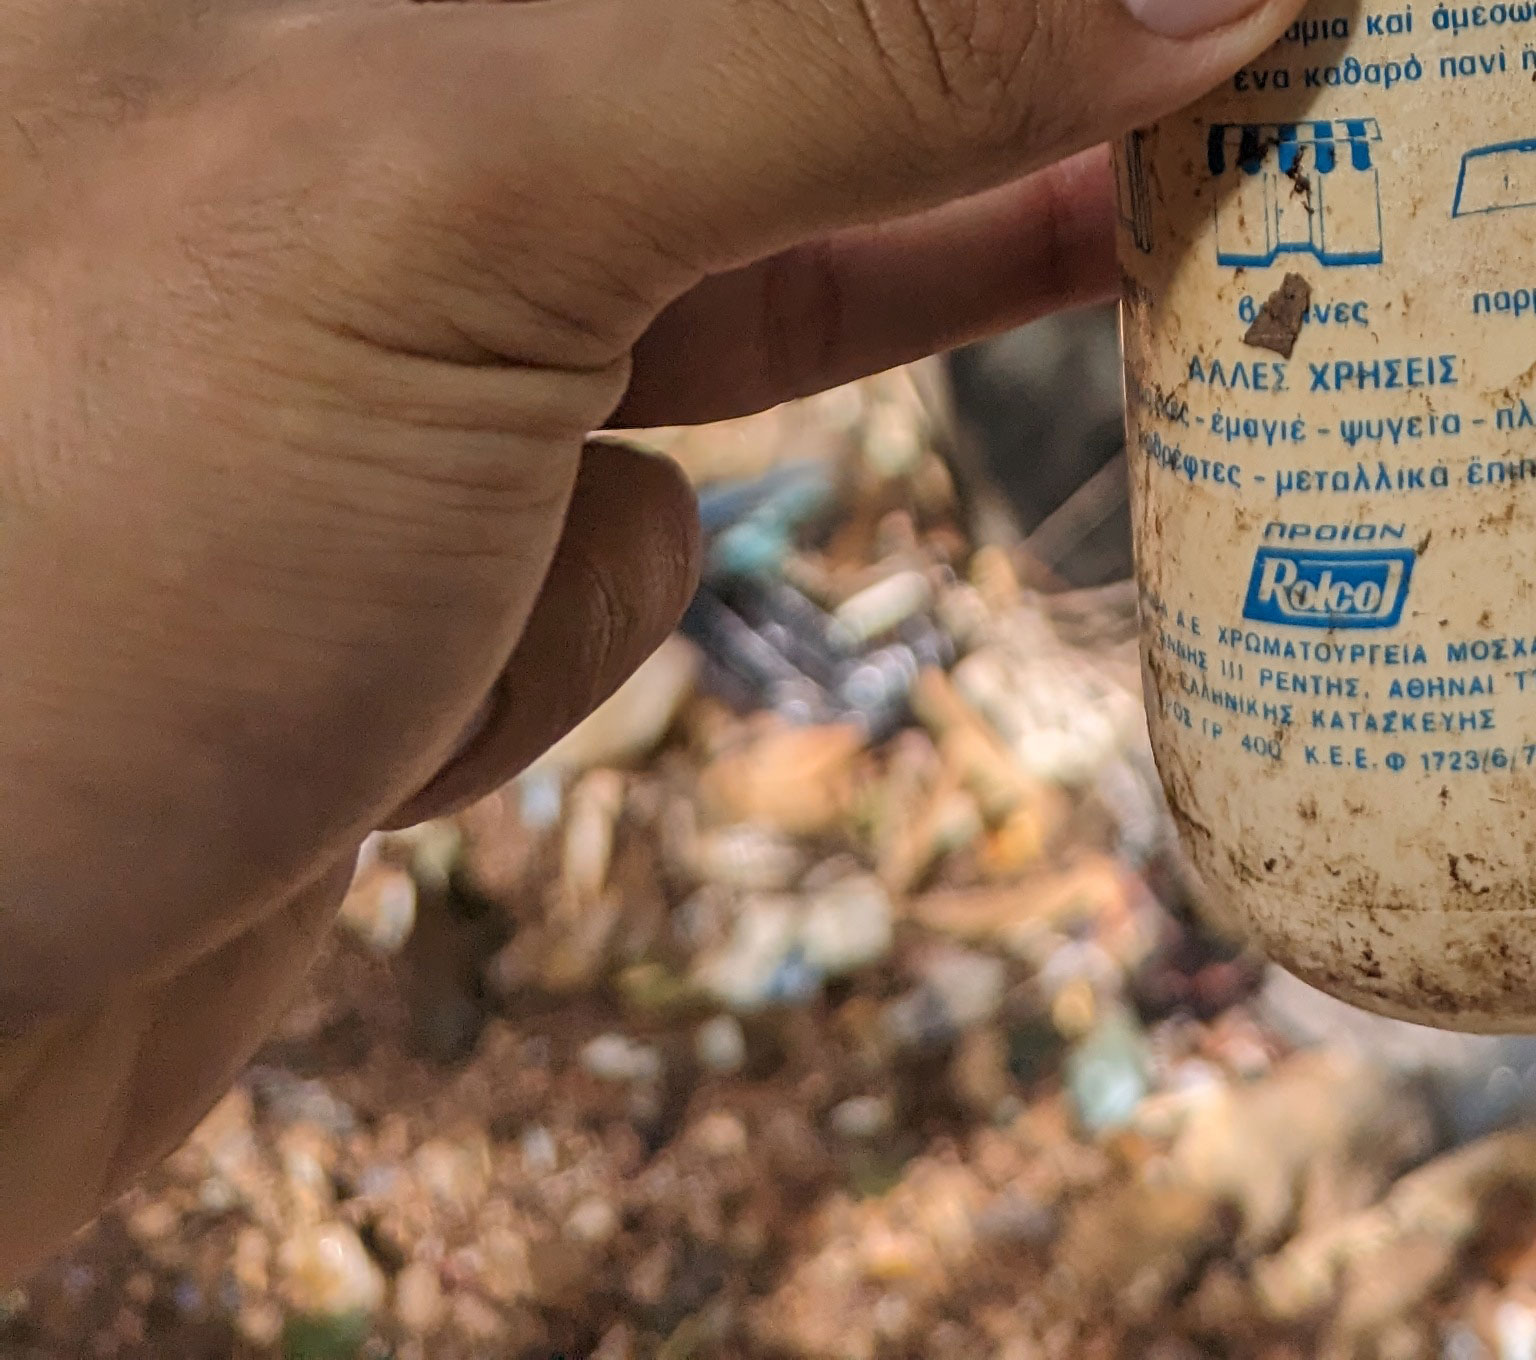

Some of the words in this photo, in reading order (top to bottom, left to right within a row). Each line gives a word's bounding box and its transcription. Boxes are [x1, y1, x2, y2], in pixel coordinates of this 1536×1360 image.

[1308, 355, 1458, 391] ΧΡΗΣΕΙΣ
[1256, 556, 1404, 618] Rolco
[1218, 625, 1427, 665] ΧΡΩΜΑΤΟΥΡΓΕΙΑ
[1389, 674, 1493, 699] ΑΘΗΝΑΙ
[1312, 709, 1495, 732] ΚΑΤΑΣΚΕΥΗΣ
